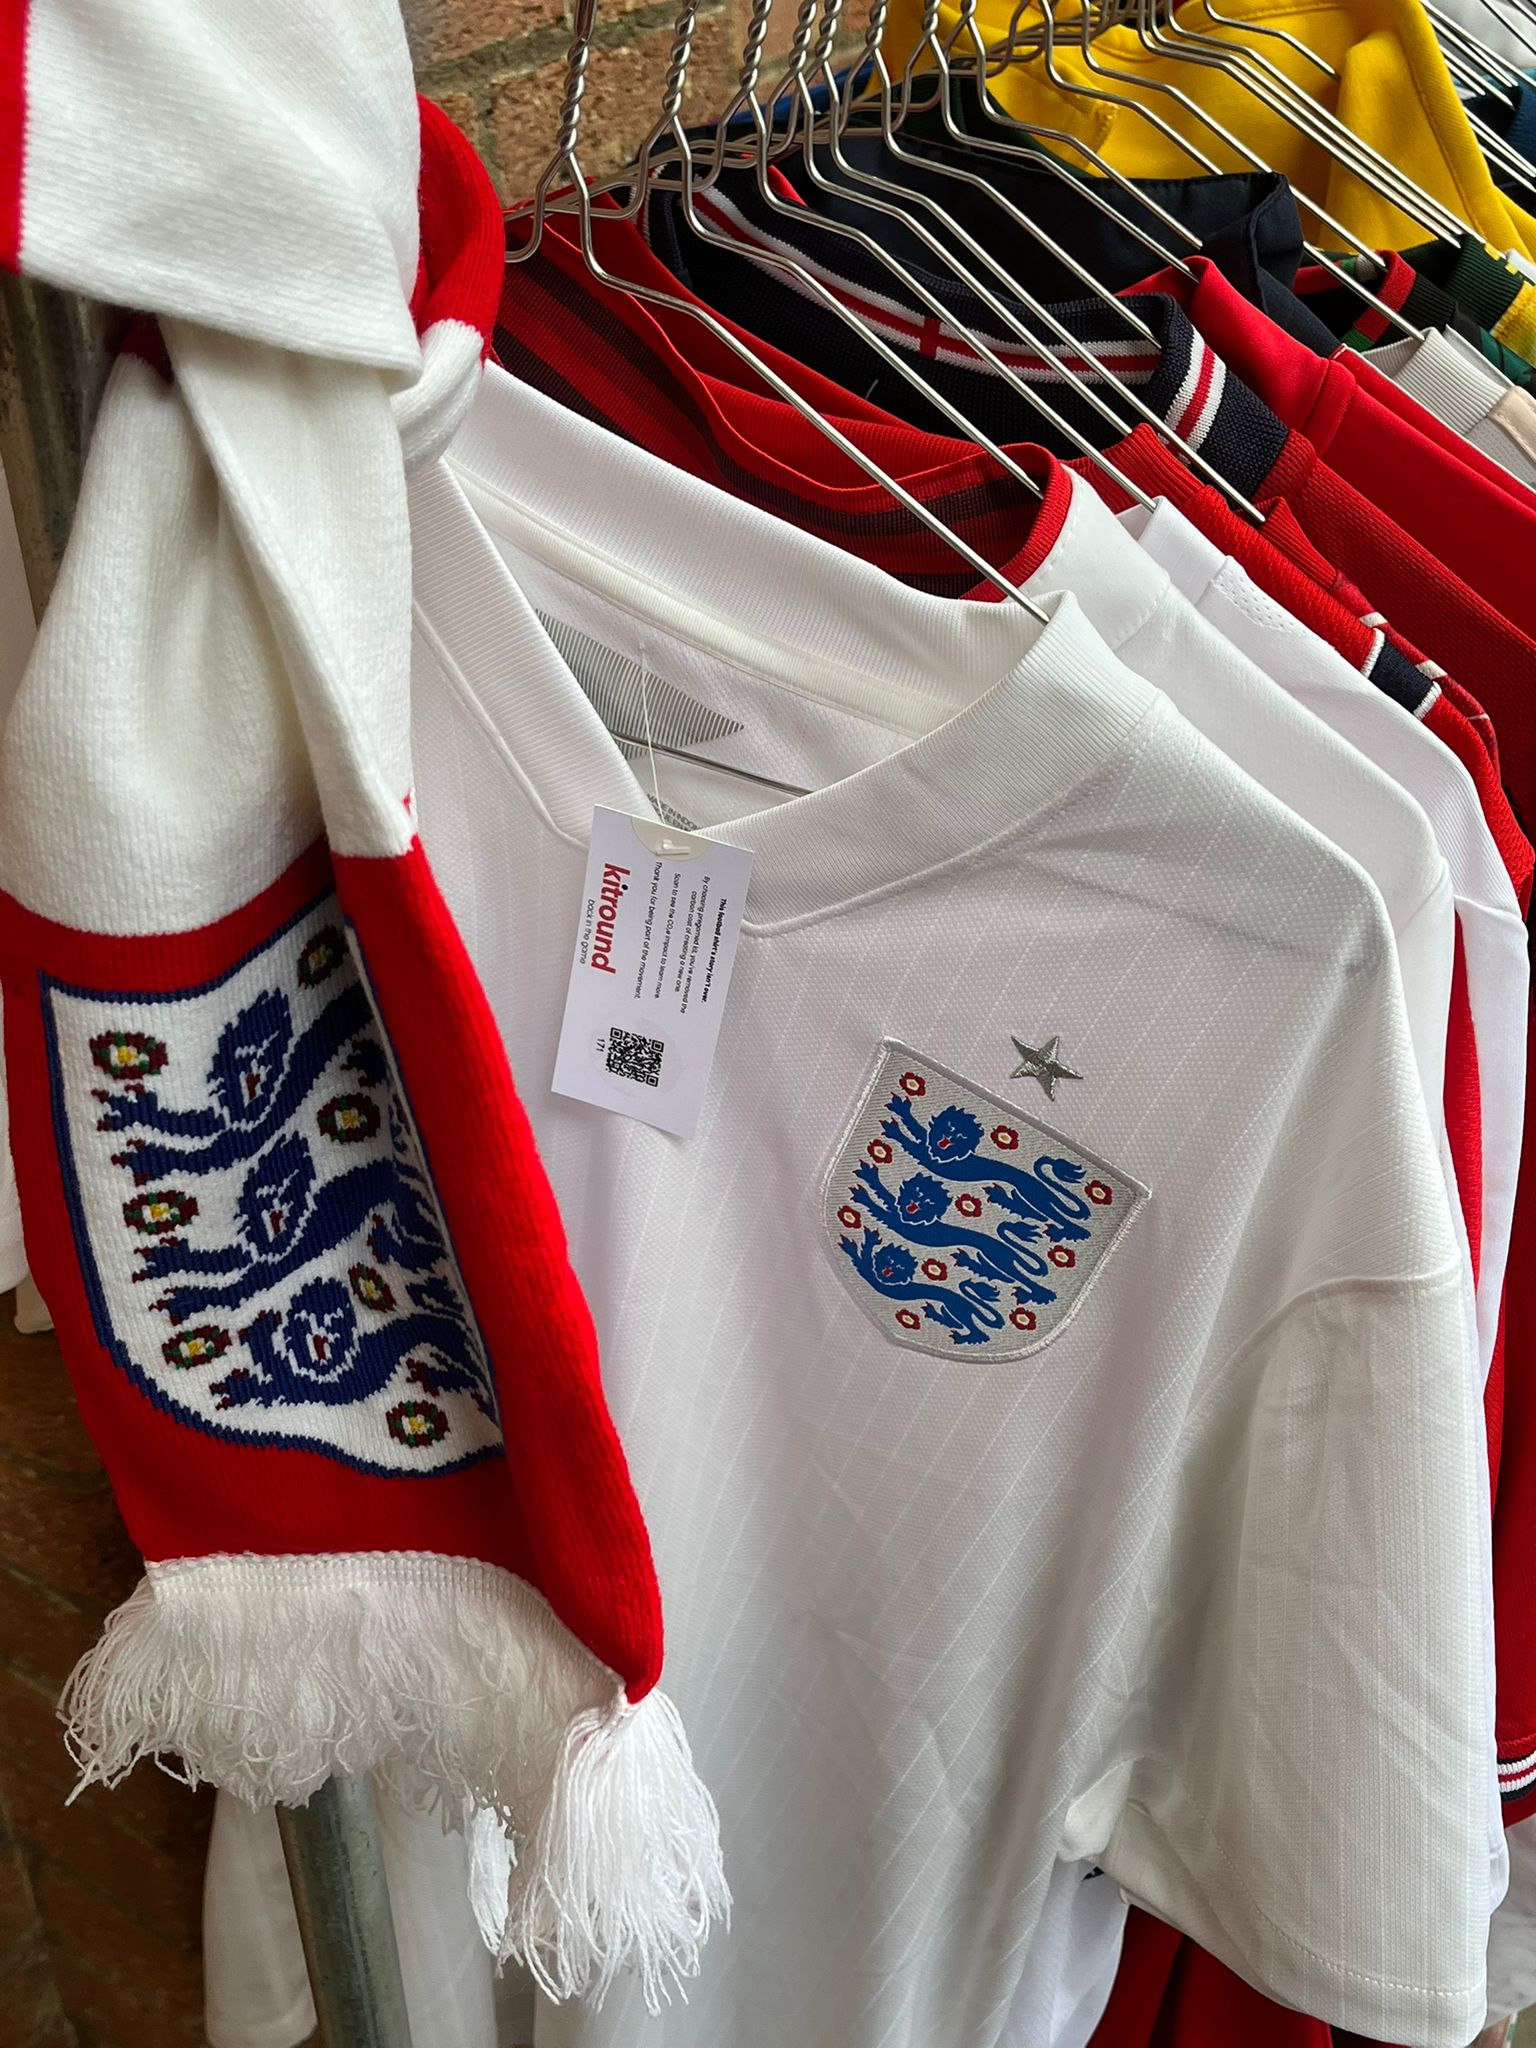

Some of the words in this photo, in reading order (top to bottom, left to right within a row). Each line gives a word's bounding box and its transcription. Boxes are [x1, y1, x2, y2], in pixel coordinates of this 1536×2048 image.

[653, 862, 662, 881] Thank
[673, 873, 681, 888] Scan
[702, 876, 710, 884] By
[689, 891, 697, 912] carbon
[697, 885, 708, 912] choosing
[719, 899, 727, 911] This
[587, 899, 595, 918] back
[645, 906, 655, 925] being
[591, 863, 630, 974] kitround
[715, 912, 724, 936] football
[580, 942, 588, 964] game
[643, 941, 649, 949] of
[662, 935, 670, 957] impact
[679, 935, 689, 960] creating
[706, 956, 715, 972] story
[682, 975, 691, 1003] removed
[596, 1039, 605, 1052] 171
